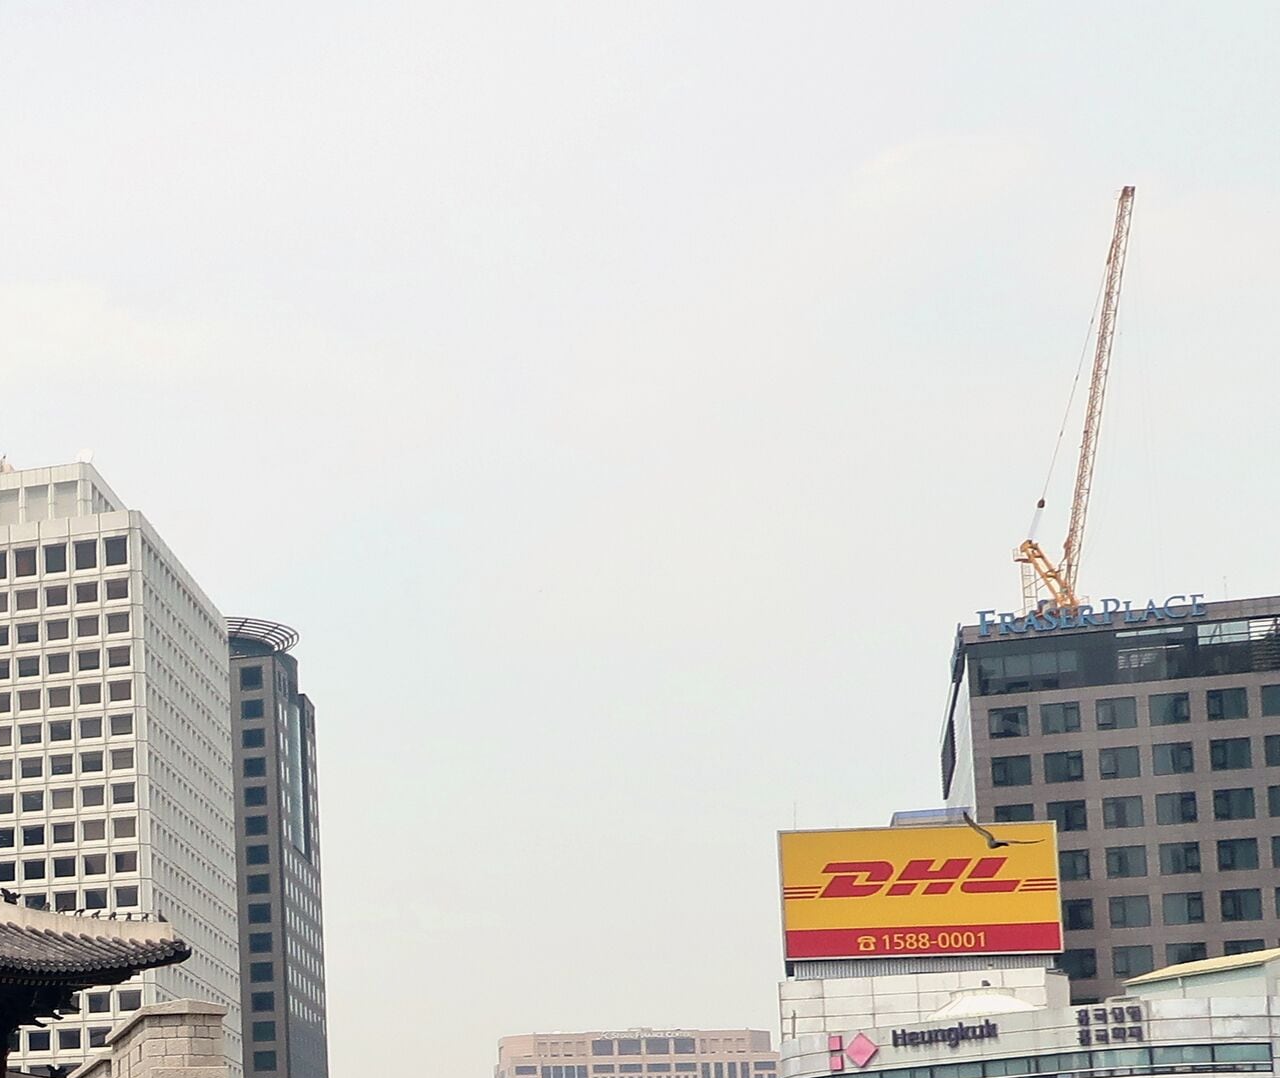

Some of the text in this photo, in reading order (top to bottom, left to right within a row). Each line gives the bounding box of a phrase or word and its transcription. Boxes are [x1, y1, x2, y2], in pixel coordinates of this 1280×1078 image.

[818, 856, 1022, 899] DHL
[881, 931, 987, 951] 1588-0001
[892, 1018, 999, 1048] Heungkuk
